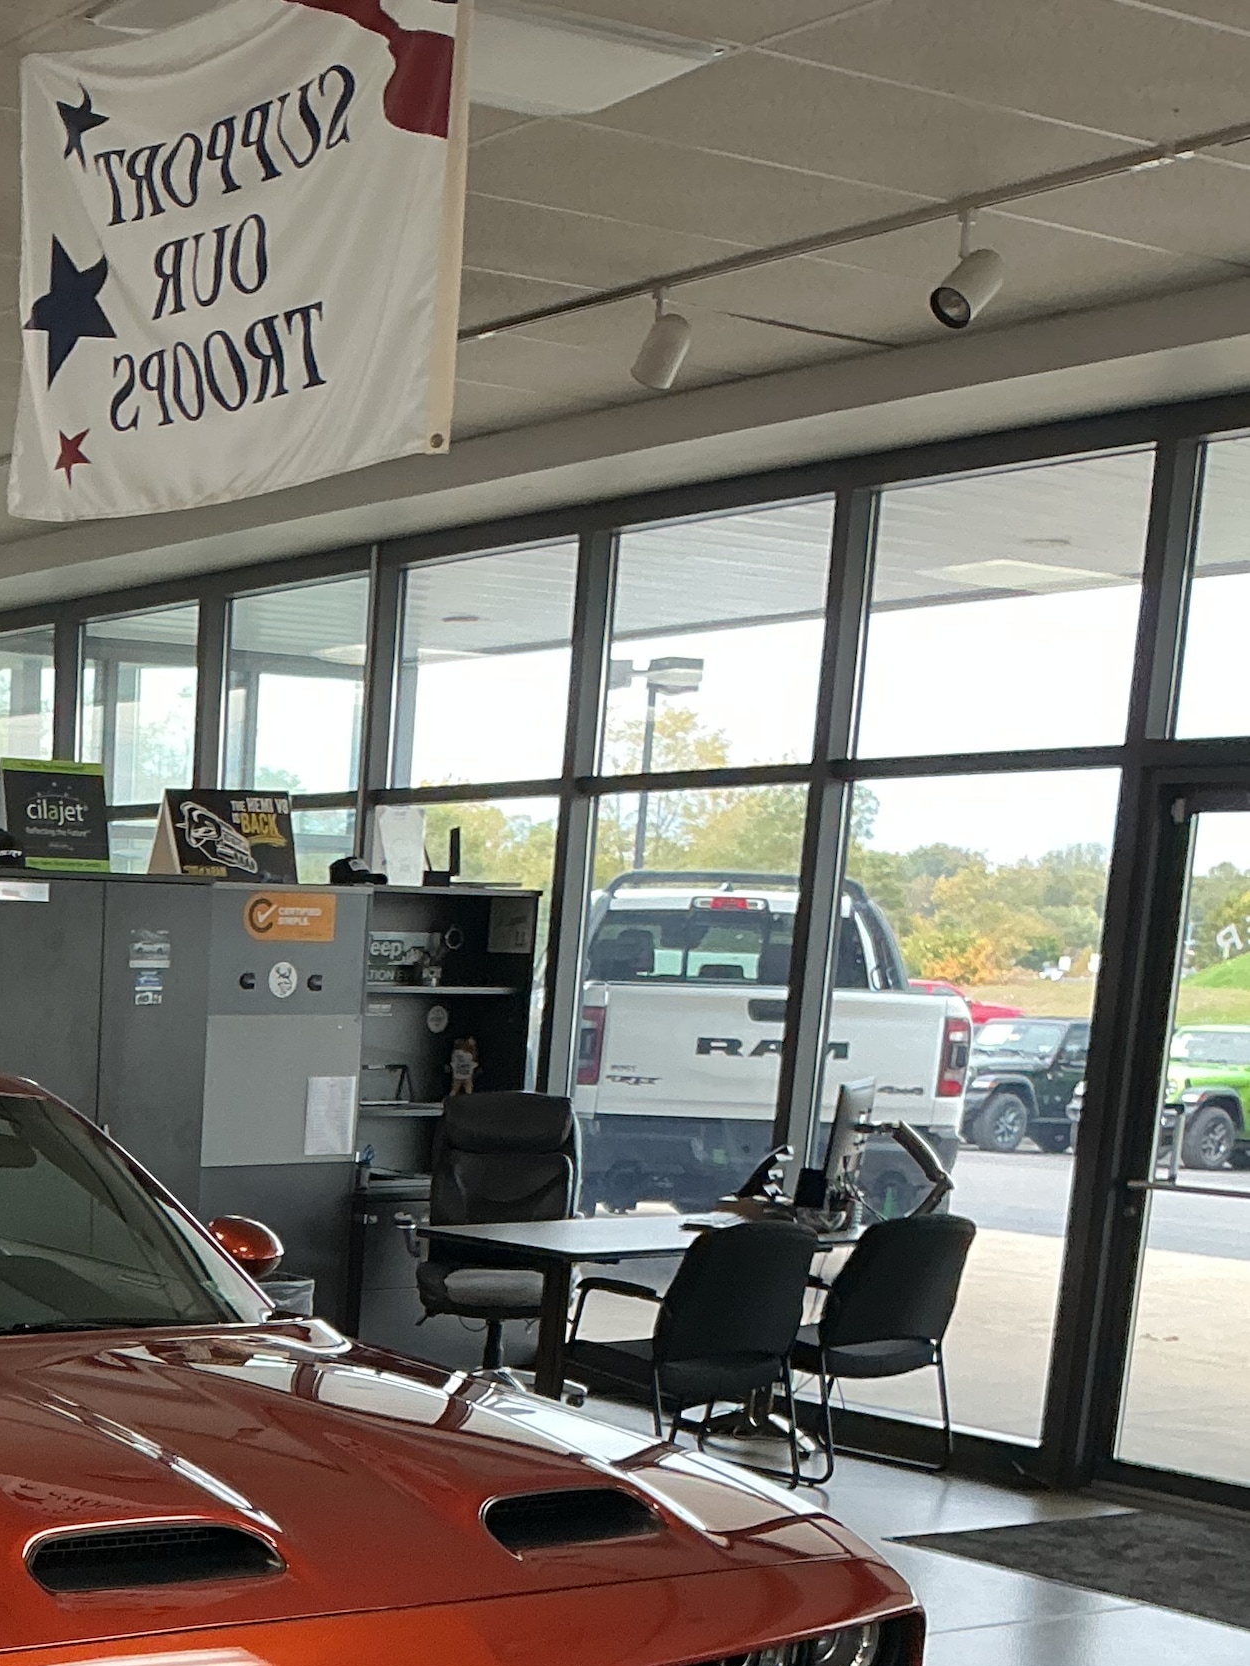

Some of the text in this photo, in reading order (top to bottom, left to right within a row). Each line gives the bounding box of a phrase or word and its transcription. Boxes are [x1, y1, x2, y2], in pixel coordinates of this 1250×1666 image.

[26, 799, 85, 826] cilajet
[240, 812, 280, 836] BACK
[369, 940, 403, 961] eep
